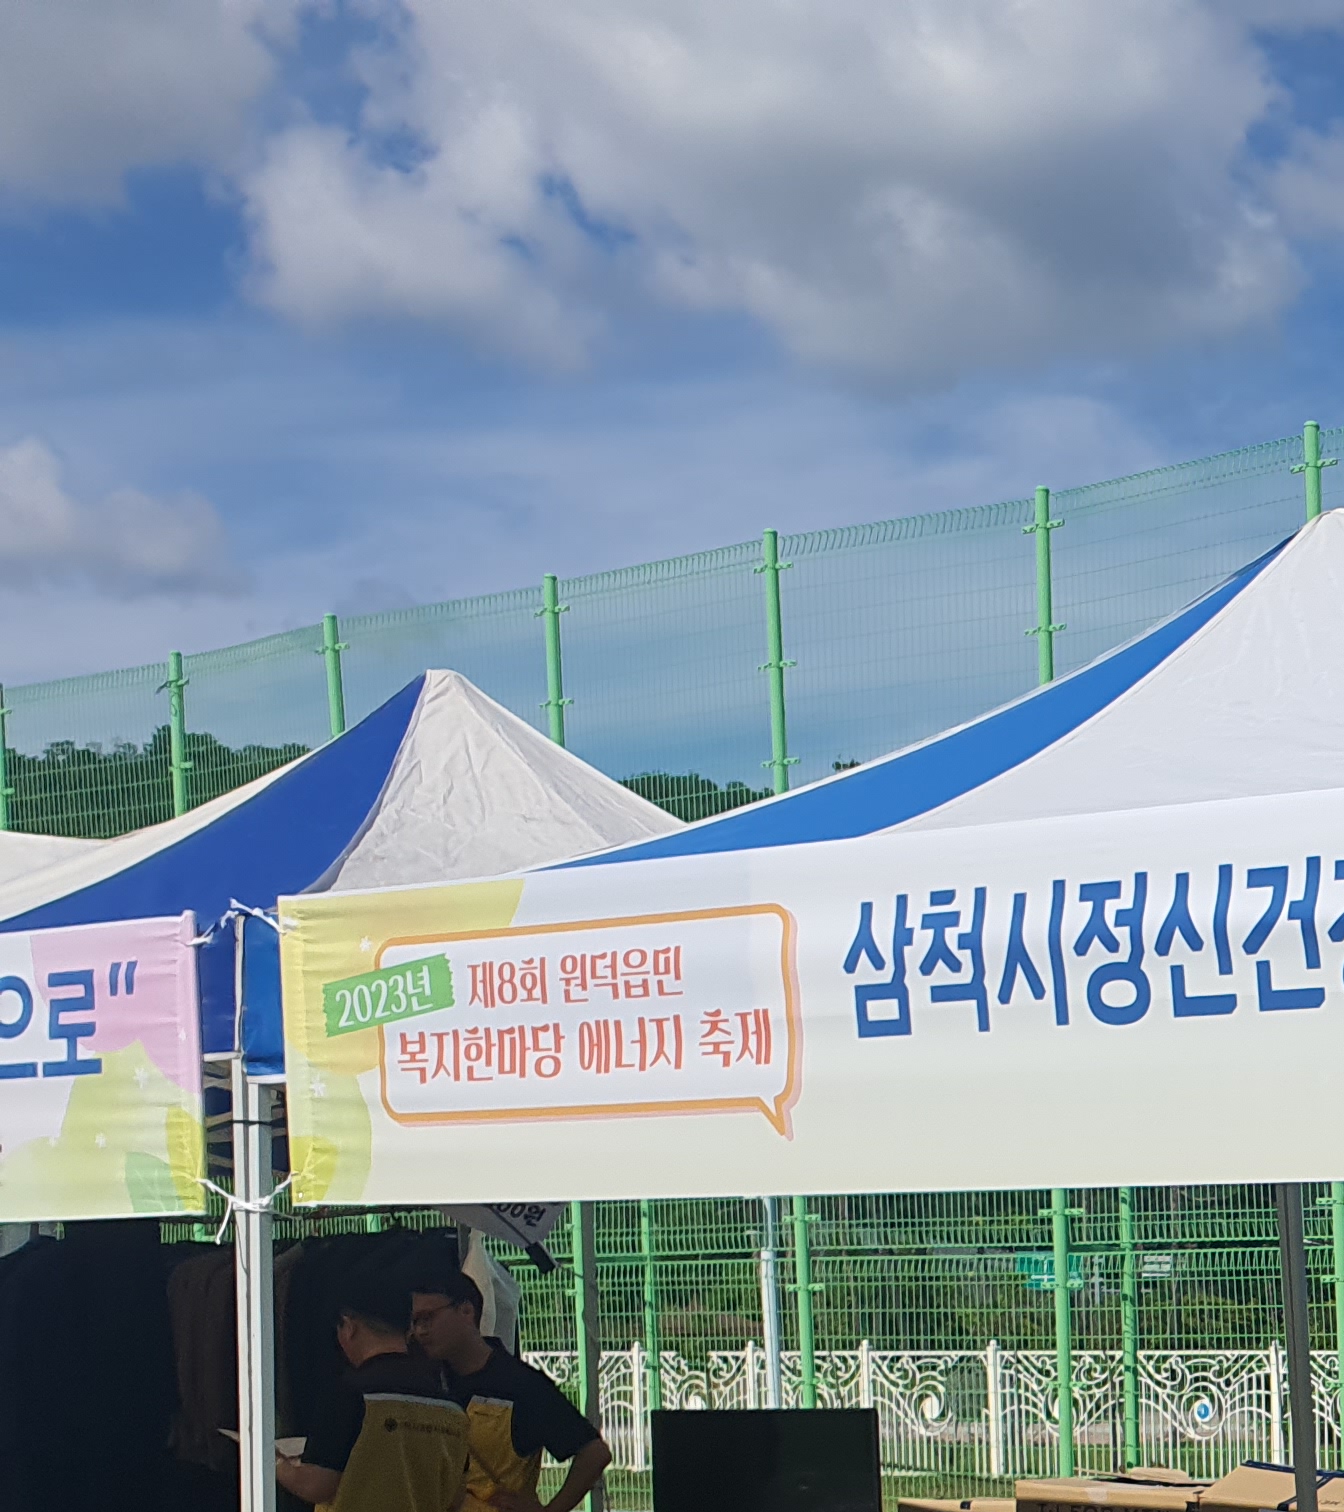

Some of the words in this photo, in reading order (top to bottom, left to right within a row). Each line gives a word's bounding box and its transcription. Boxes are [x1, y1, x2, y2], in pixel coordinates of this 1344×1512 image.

[335, 961, 434, 1028] 2023년
[466, 953, 548, 1008] 제8회
[558, 945, 685, 1006] 원덕읍민
[398, 1022, 566, 1086] 복지한마당
[578, 1012, 685, 1073] 에너지
[697, 1006, 773, 1072] 축제
